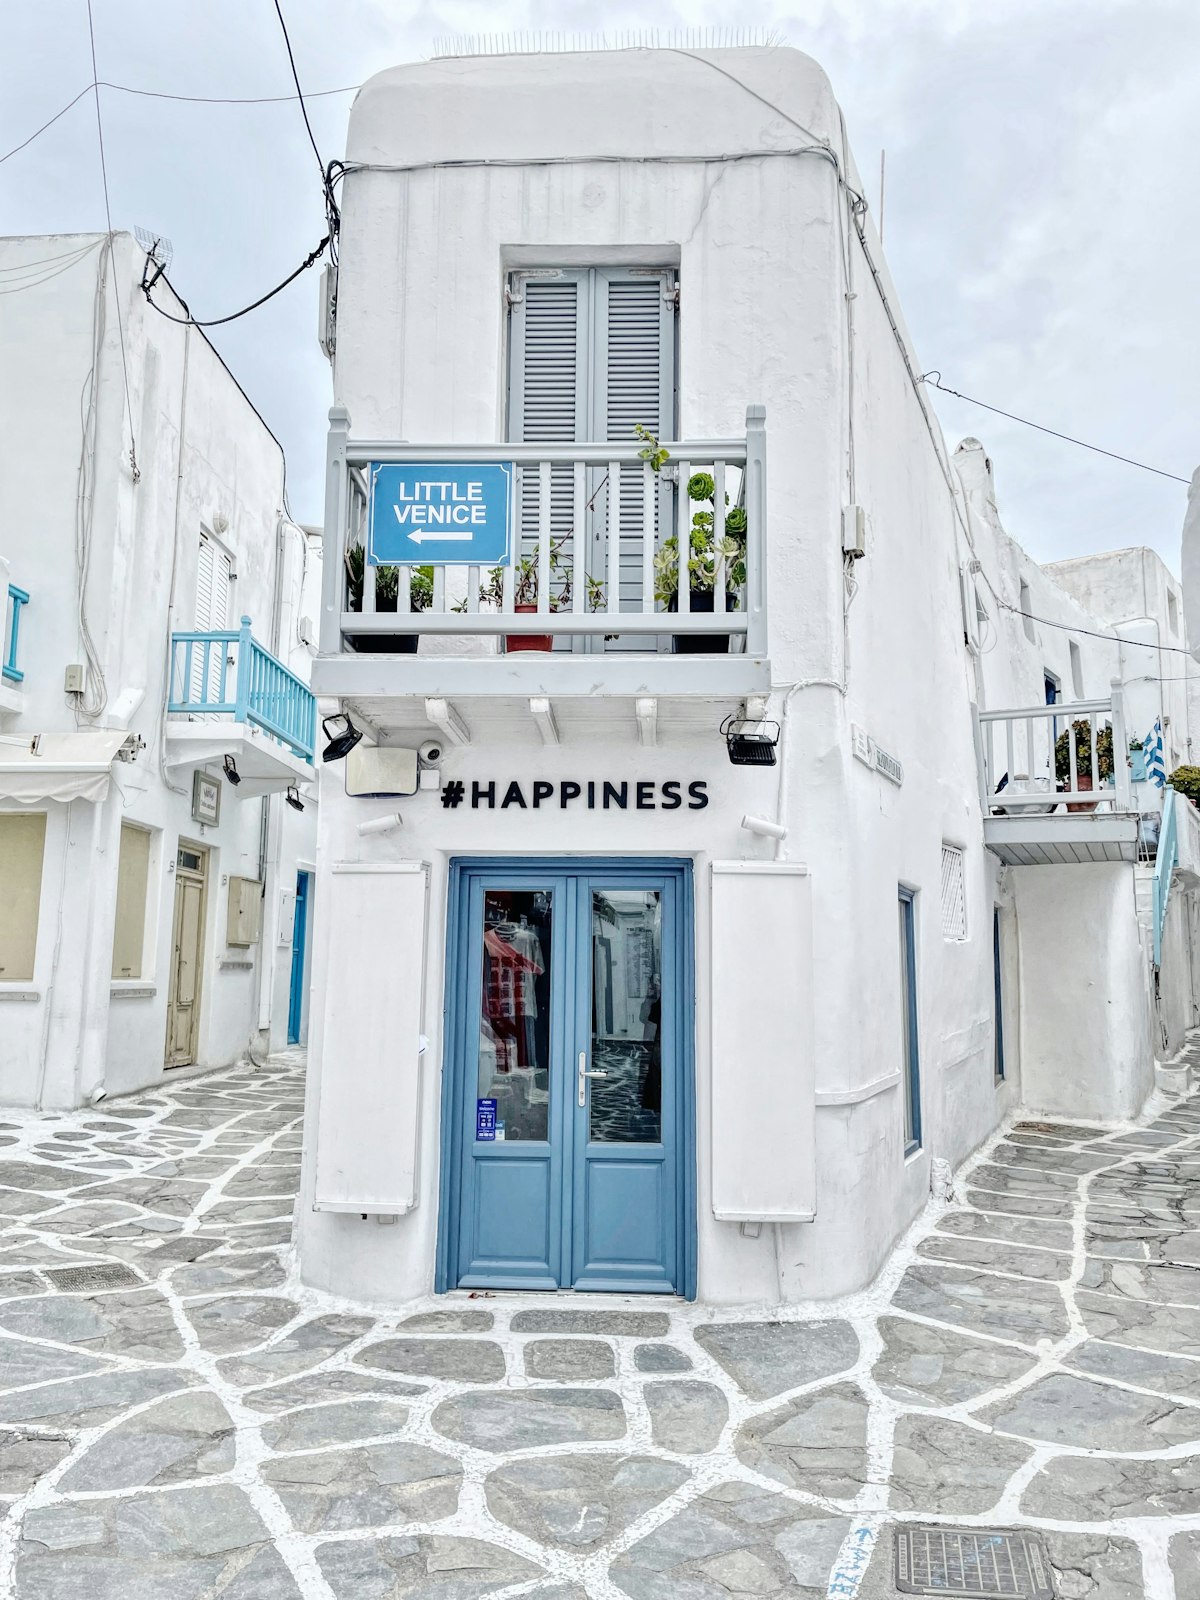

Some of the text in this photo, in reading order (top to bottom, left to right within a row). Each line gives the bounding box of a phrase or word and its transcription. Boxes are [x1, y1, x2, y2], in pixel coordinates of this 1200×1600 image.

[399, 482, 483, 501] LITTLE
[393, 504, 487, 524] VENICE
[440, 780, 709, 810] #HAPPINESS
